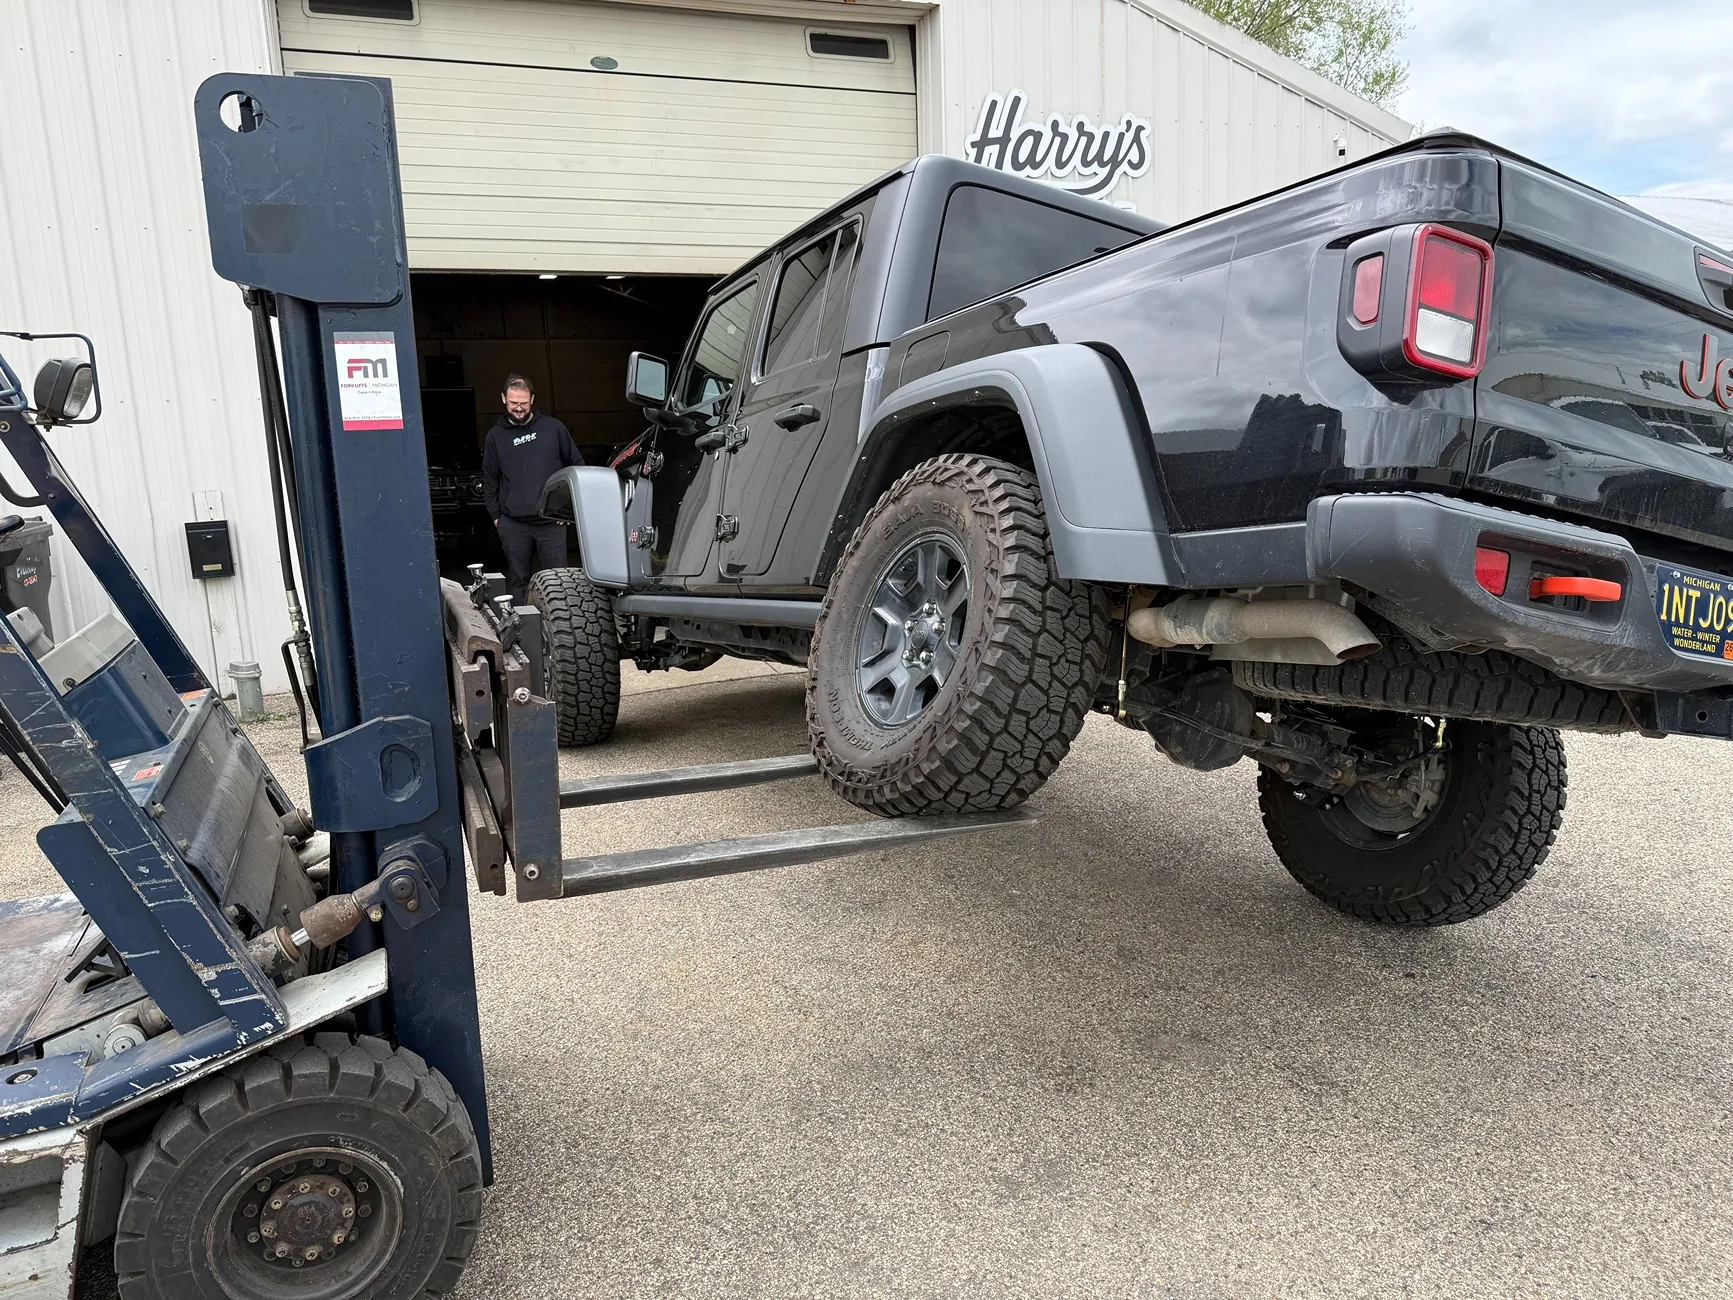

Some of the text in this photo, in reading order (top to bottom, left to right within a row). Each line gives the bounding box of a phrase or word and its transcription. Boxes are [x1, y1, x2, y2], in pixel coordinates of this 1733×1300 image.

[970, 94, 1147, 196] Harry's
[1683, 575, 1720, 592] MICHIGAN
[1671, 626, 1692, 638] WATER
[1697, 631, 1721, 644] WINTER
[1673, 638, 1716, 653] WONDERLAND
